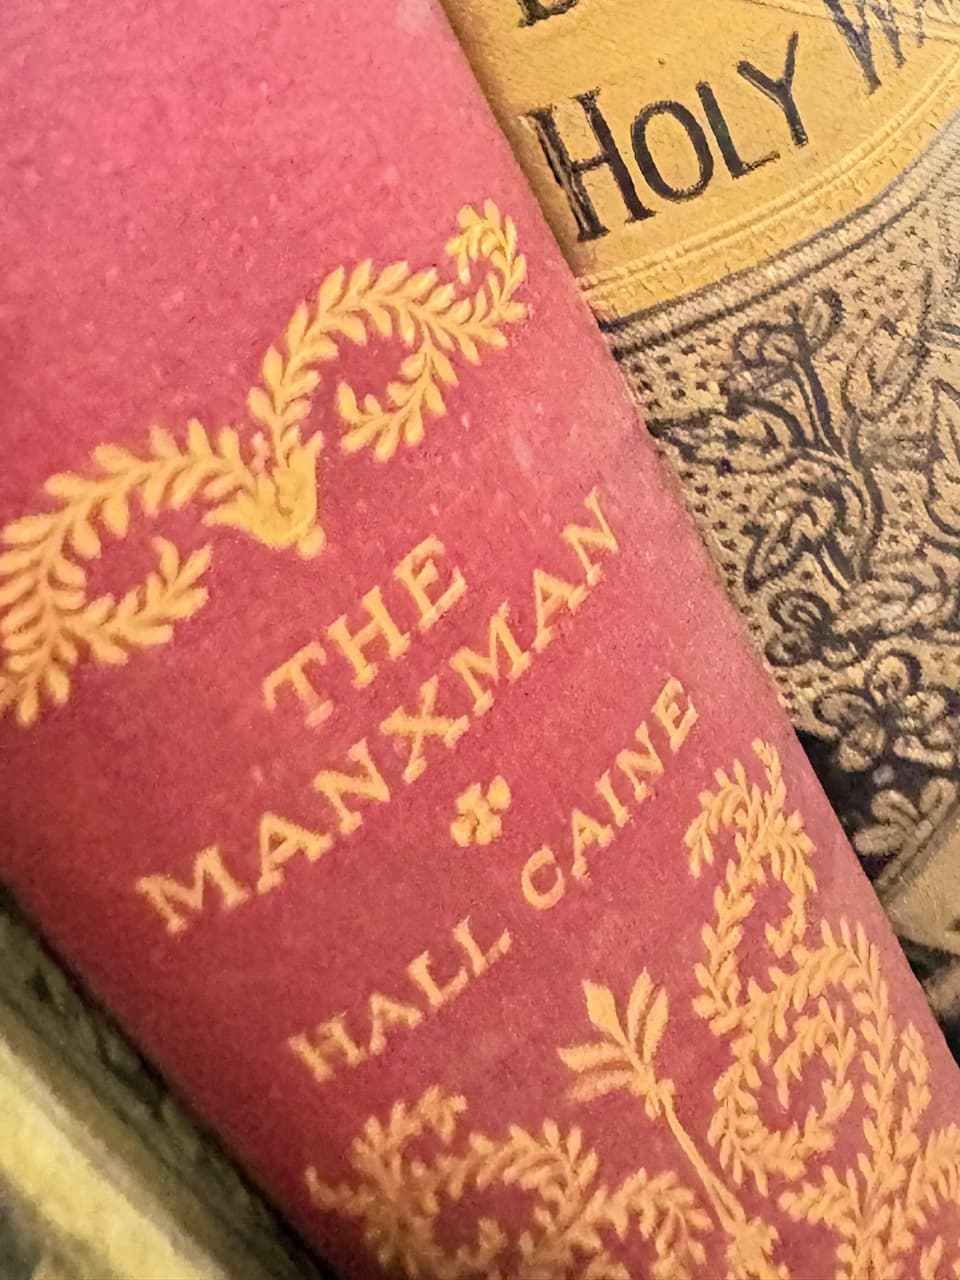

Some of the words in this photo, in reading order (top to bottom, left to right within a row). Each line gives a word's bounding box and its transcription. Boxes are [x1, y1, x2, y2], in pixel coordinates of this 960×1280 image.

[520, 30, 810, 242] HOLY
[135, 489, 621, 936] MANXMAN
[262, 535, 467, 726] THE
[288, 917, 513, 1083] HALL
[520, 676, 699, 911] CAINE
